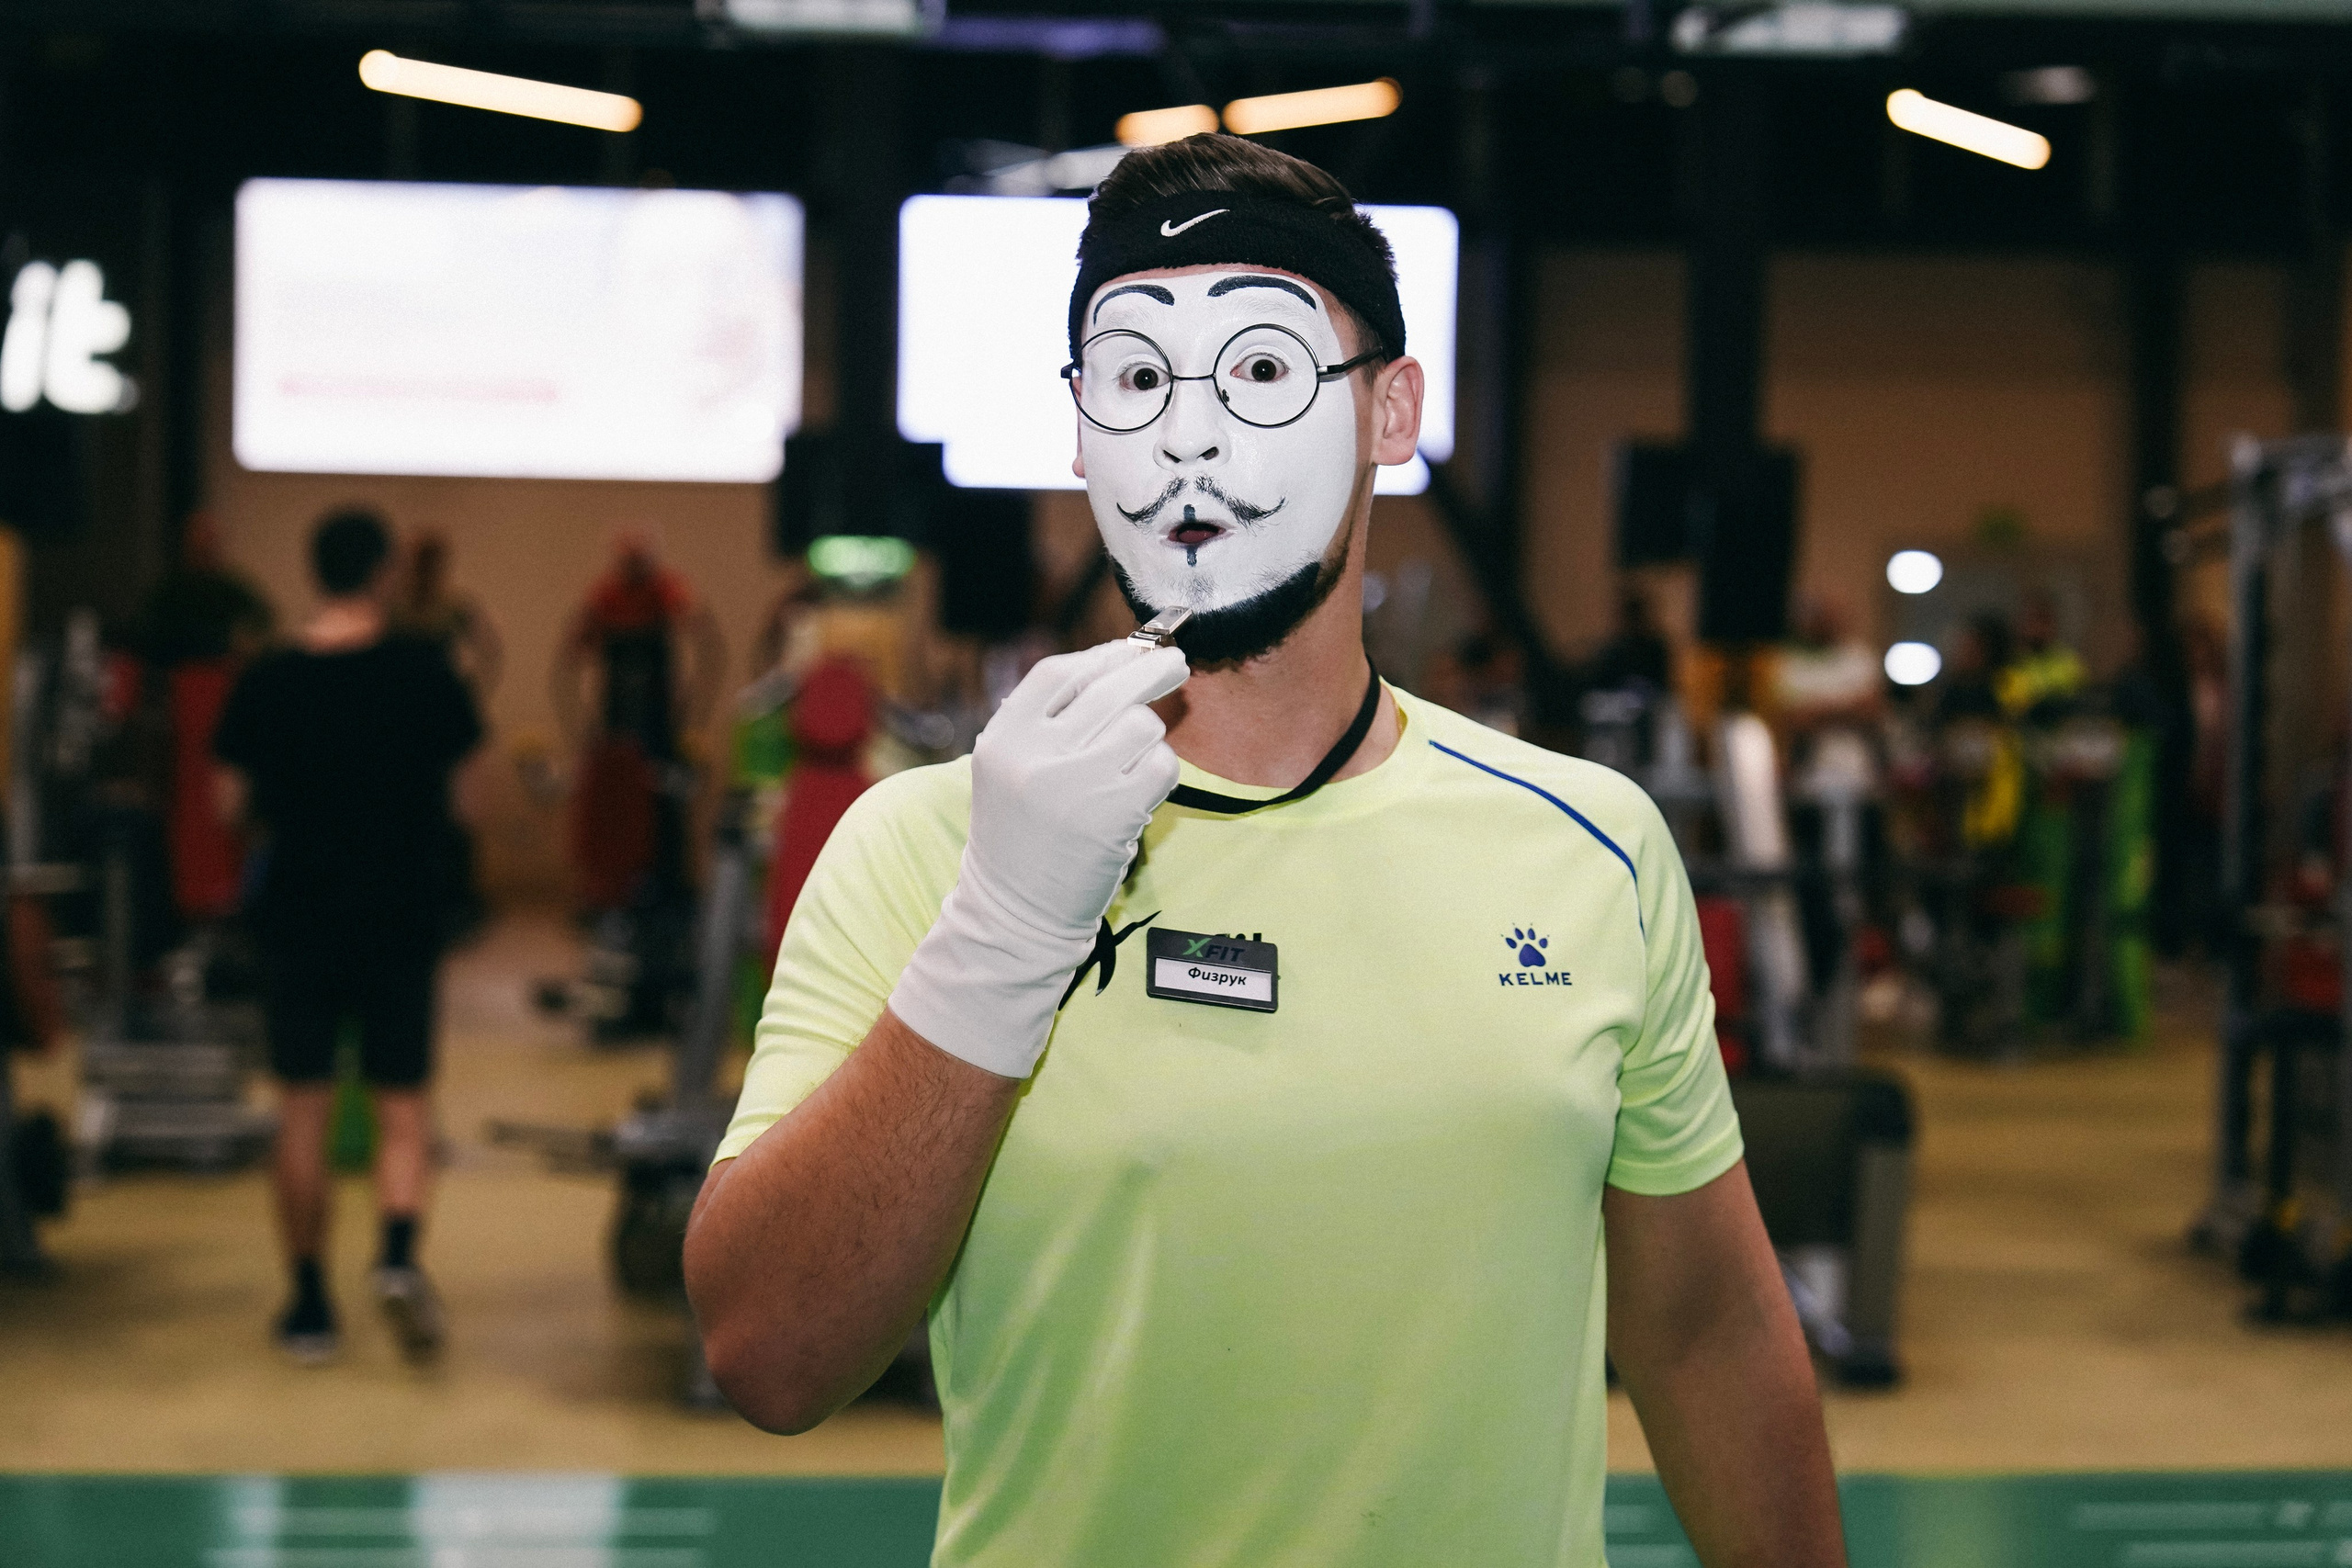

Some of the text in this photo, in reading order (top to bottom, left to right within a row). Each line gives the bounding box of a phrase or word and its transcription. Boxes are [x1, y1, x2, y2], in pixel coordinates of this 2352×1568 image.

[1182, 937, 1246, 963] XFIT
[1188, 967, 1247, 987] Физрук
[1498, 972, 1573, 987] KELME
